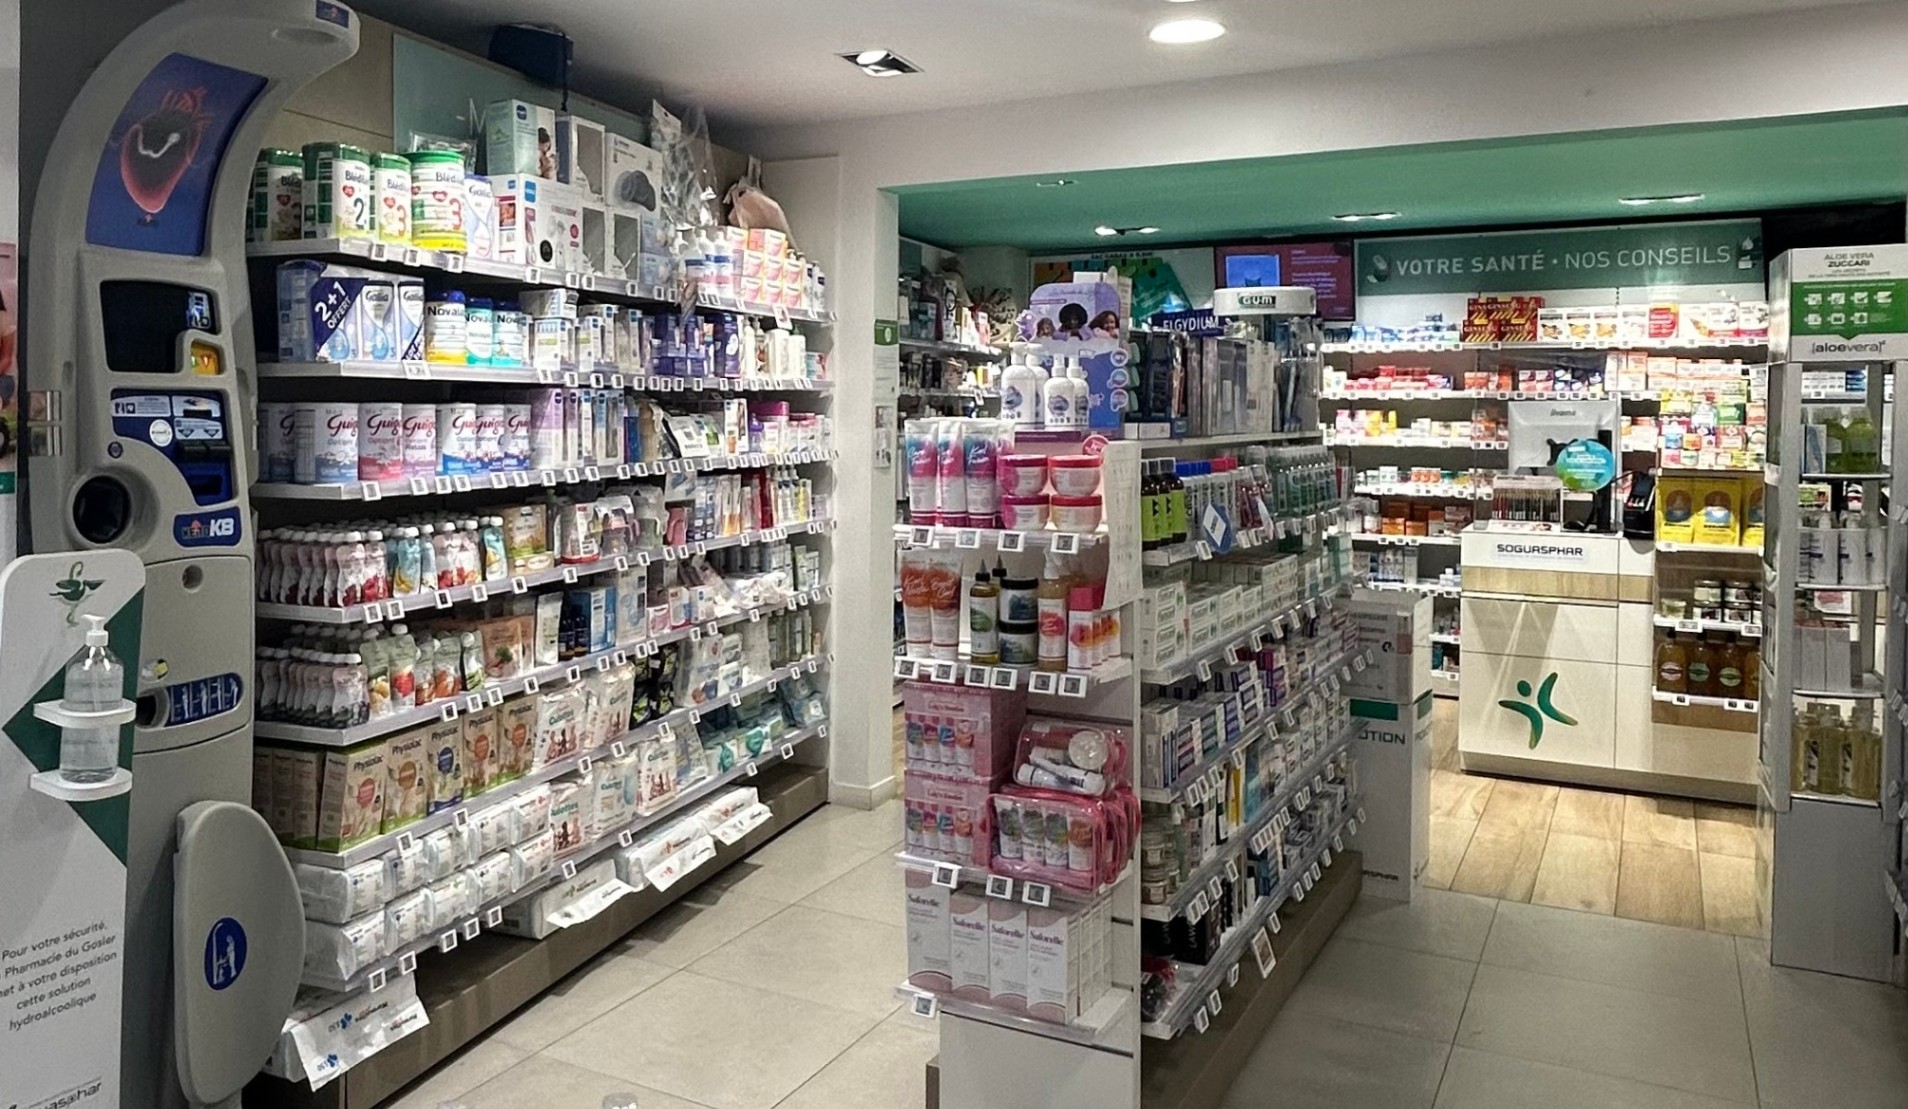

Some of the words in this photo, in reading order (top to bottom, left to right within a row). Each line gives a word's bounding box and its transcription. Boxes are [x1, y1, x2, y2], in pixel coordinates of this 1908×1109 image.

[354, 197, 366, 224] 2
[396, 205, 407, 237] 3
[449, 198, 462, 230] 3
[1397, 257, 1464, 275] VOTRE
[1471, 249, 1545, 273] SANTÉ
[1565, 250, 1610, 269] NOS
[1617, 246, 1731, 267] CONSEILS
[1824, 253, 1848, 261] ALOE
[1849, 252, 1874, 260] VERA
[1828, 260, 1871, 268] ZUCCARI
[314, 280, 346, 322] 2+1
[327, 294, 351, 330] OFFERT
[209, 517, 234, 537] K8
[1497, 544, 1584, 556] SOGUASPHAR
[2, 946, 28, 962] Pour
[32, 936, 60, 951] votre
[5, 952, 62, 979] Pharmacie
[65, 946, 79, 958] du
[82, 934, 116, 953] Gosier
[18, 980, 26, 993] à
[29, 972, 57, 989] votre
[60, 952, 117, 977] disposition
[16, 992, 45, 1010] cette
[48, 977, 91, 1000] solution
[8, 993, 97, 1032] hydroalcoolique
